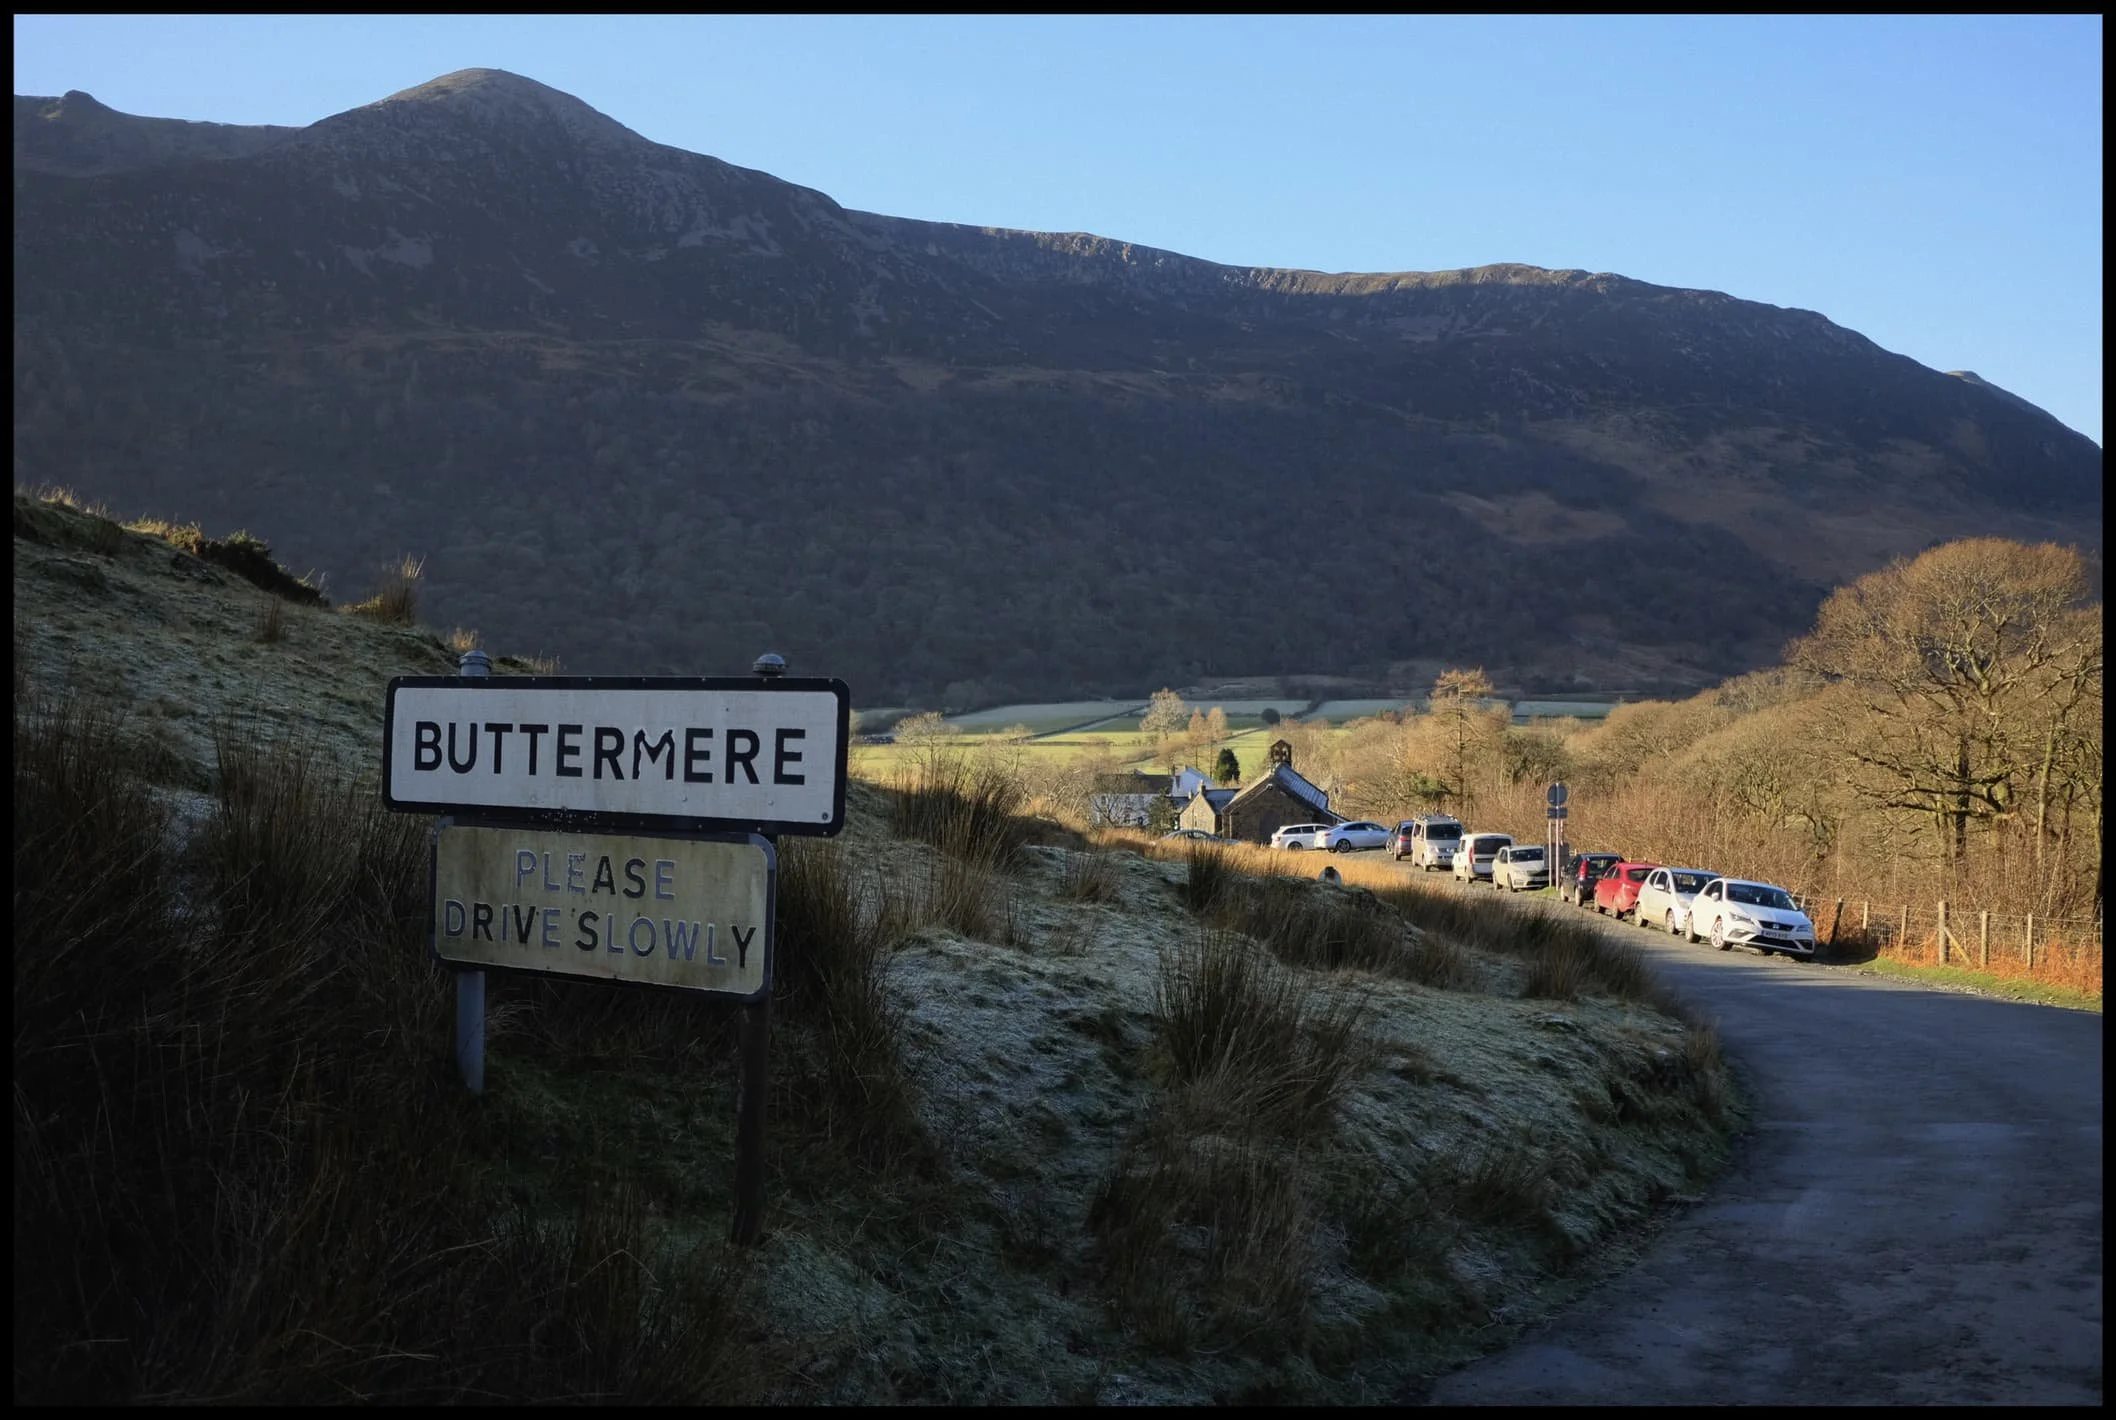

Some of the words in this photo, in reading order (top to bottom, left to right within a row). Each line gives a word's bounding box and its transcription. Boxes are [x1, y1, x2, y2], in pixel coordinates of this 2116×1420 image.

[414, 720, 806, 785] BUTTERMERE
[515, 850, 676, 900] PLEASE
[444, 898, 561, 948] DRIVE
[574, 910, 757, 968] SLOWLY
